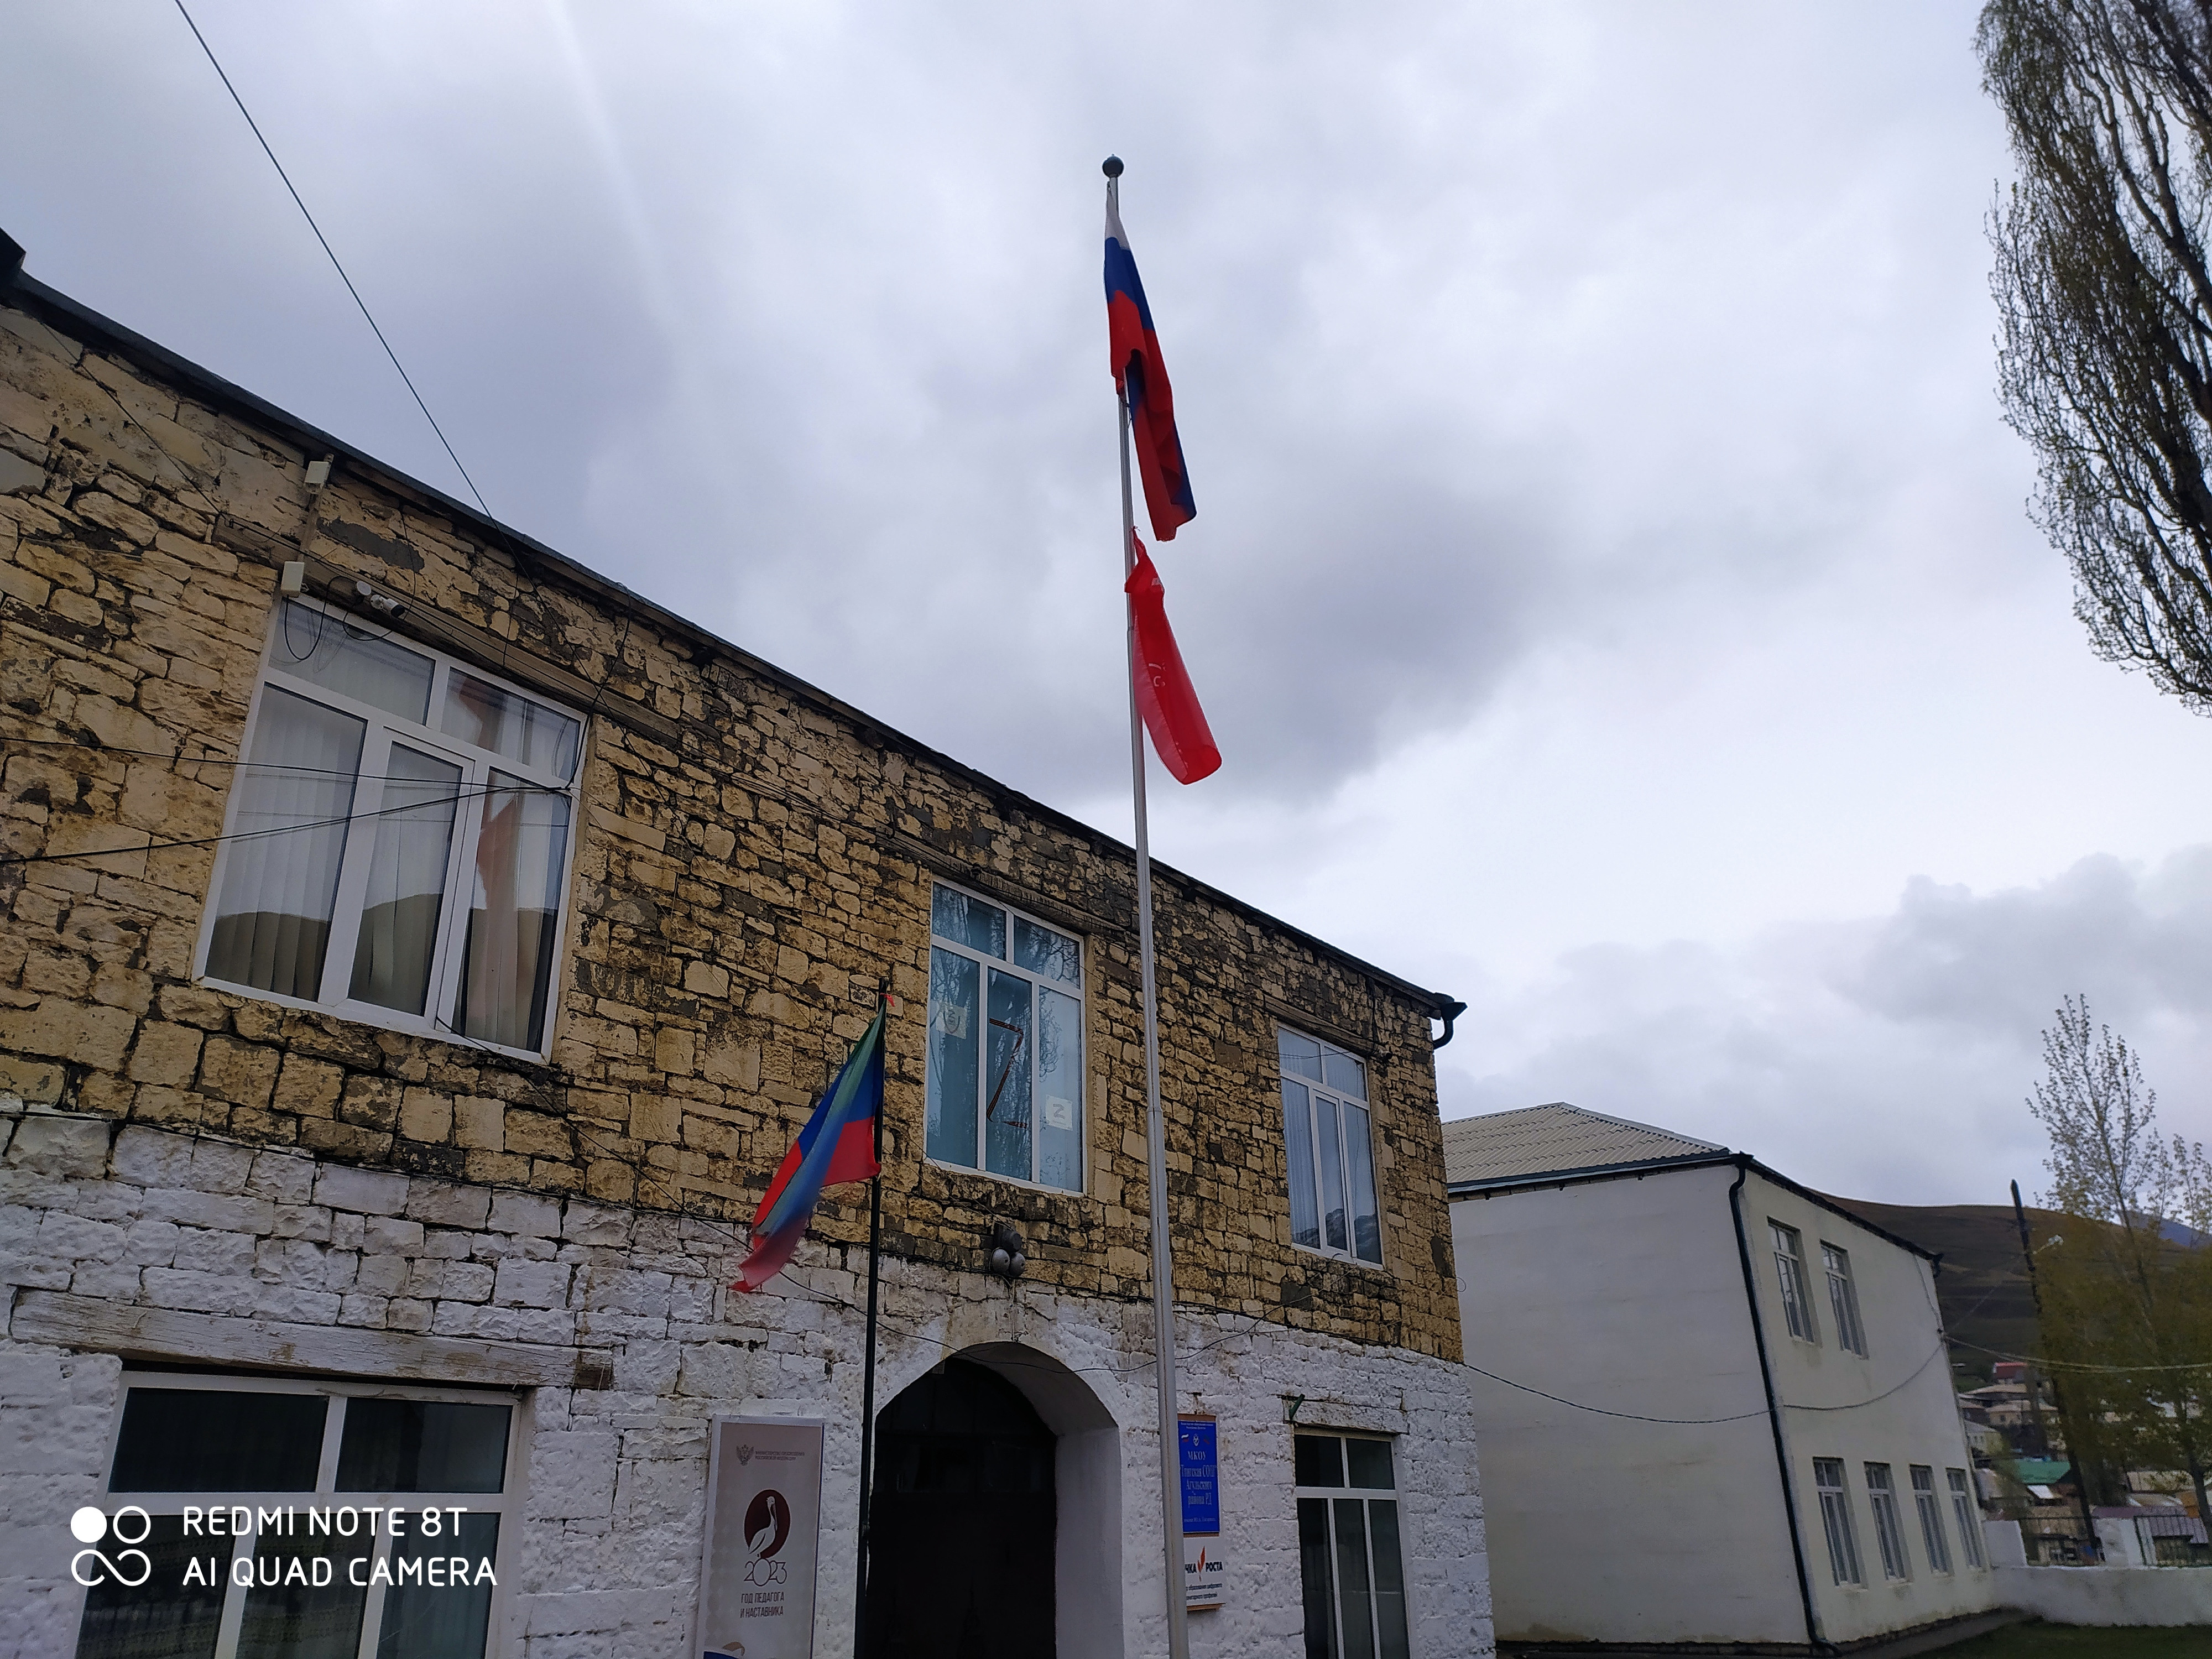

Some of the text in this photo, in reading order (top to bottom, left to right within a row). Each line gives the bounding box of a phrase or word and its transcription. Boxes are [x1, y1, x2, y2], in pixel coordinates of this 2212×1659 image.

[1187, 1451, 1206, 1460] МКОУ
[743, 1557, 787, 1587] 2023
[1185, 1561, 1223, 1574] ЧКА РОСТА
[741, 1592, 785, 1604] ГОД ПЕДАГОГА
[739, 1606, 784, 1618] И НАСТАВНИКА
